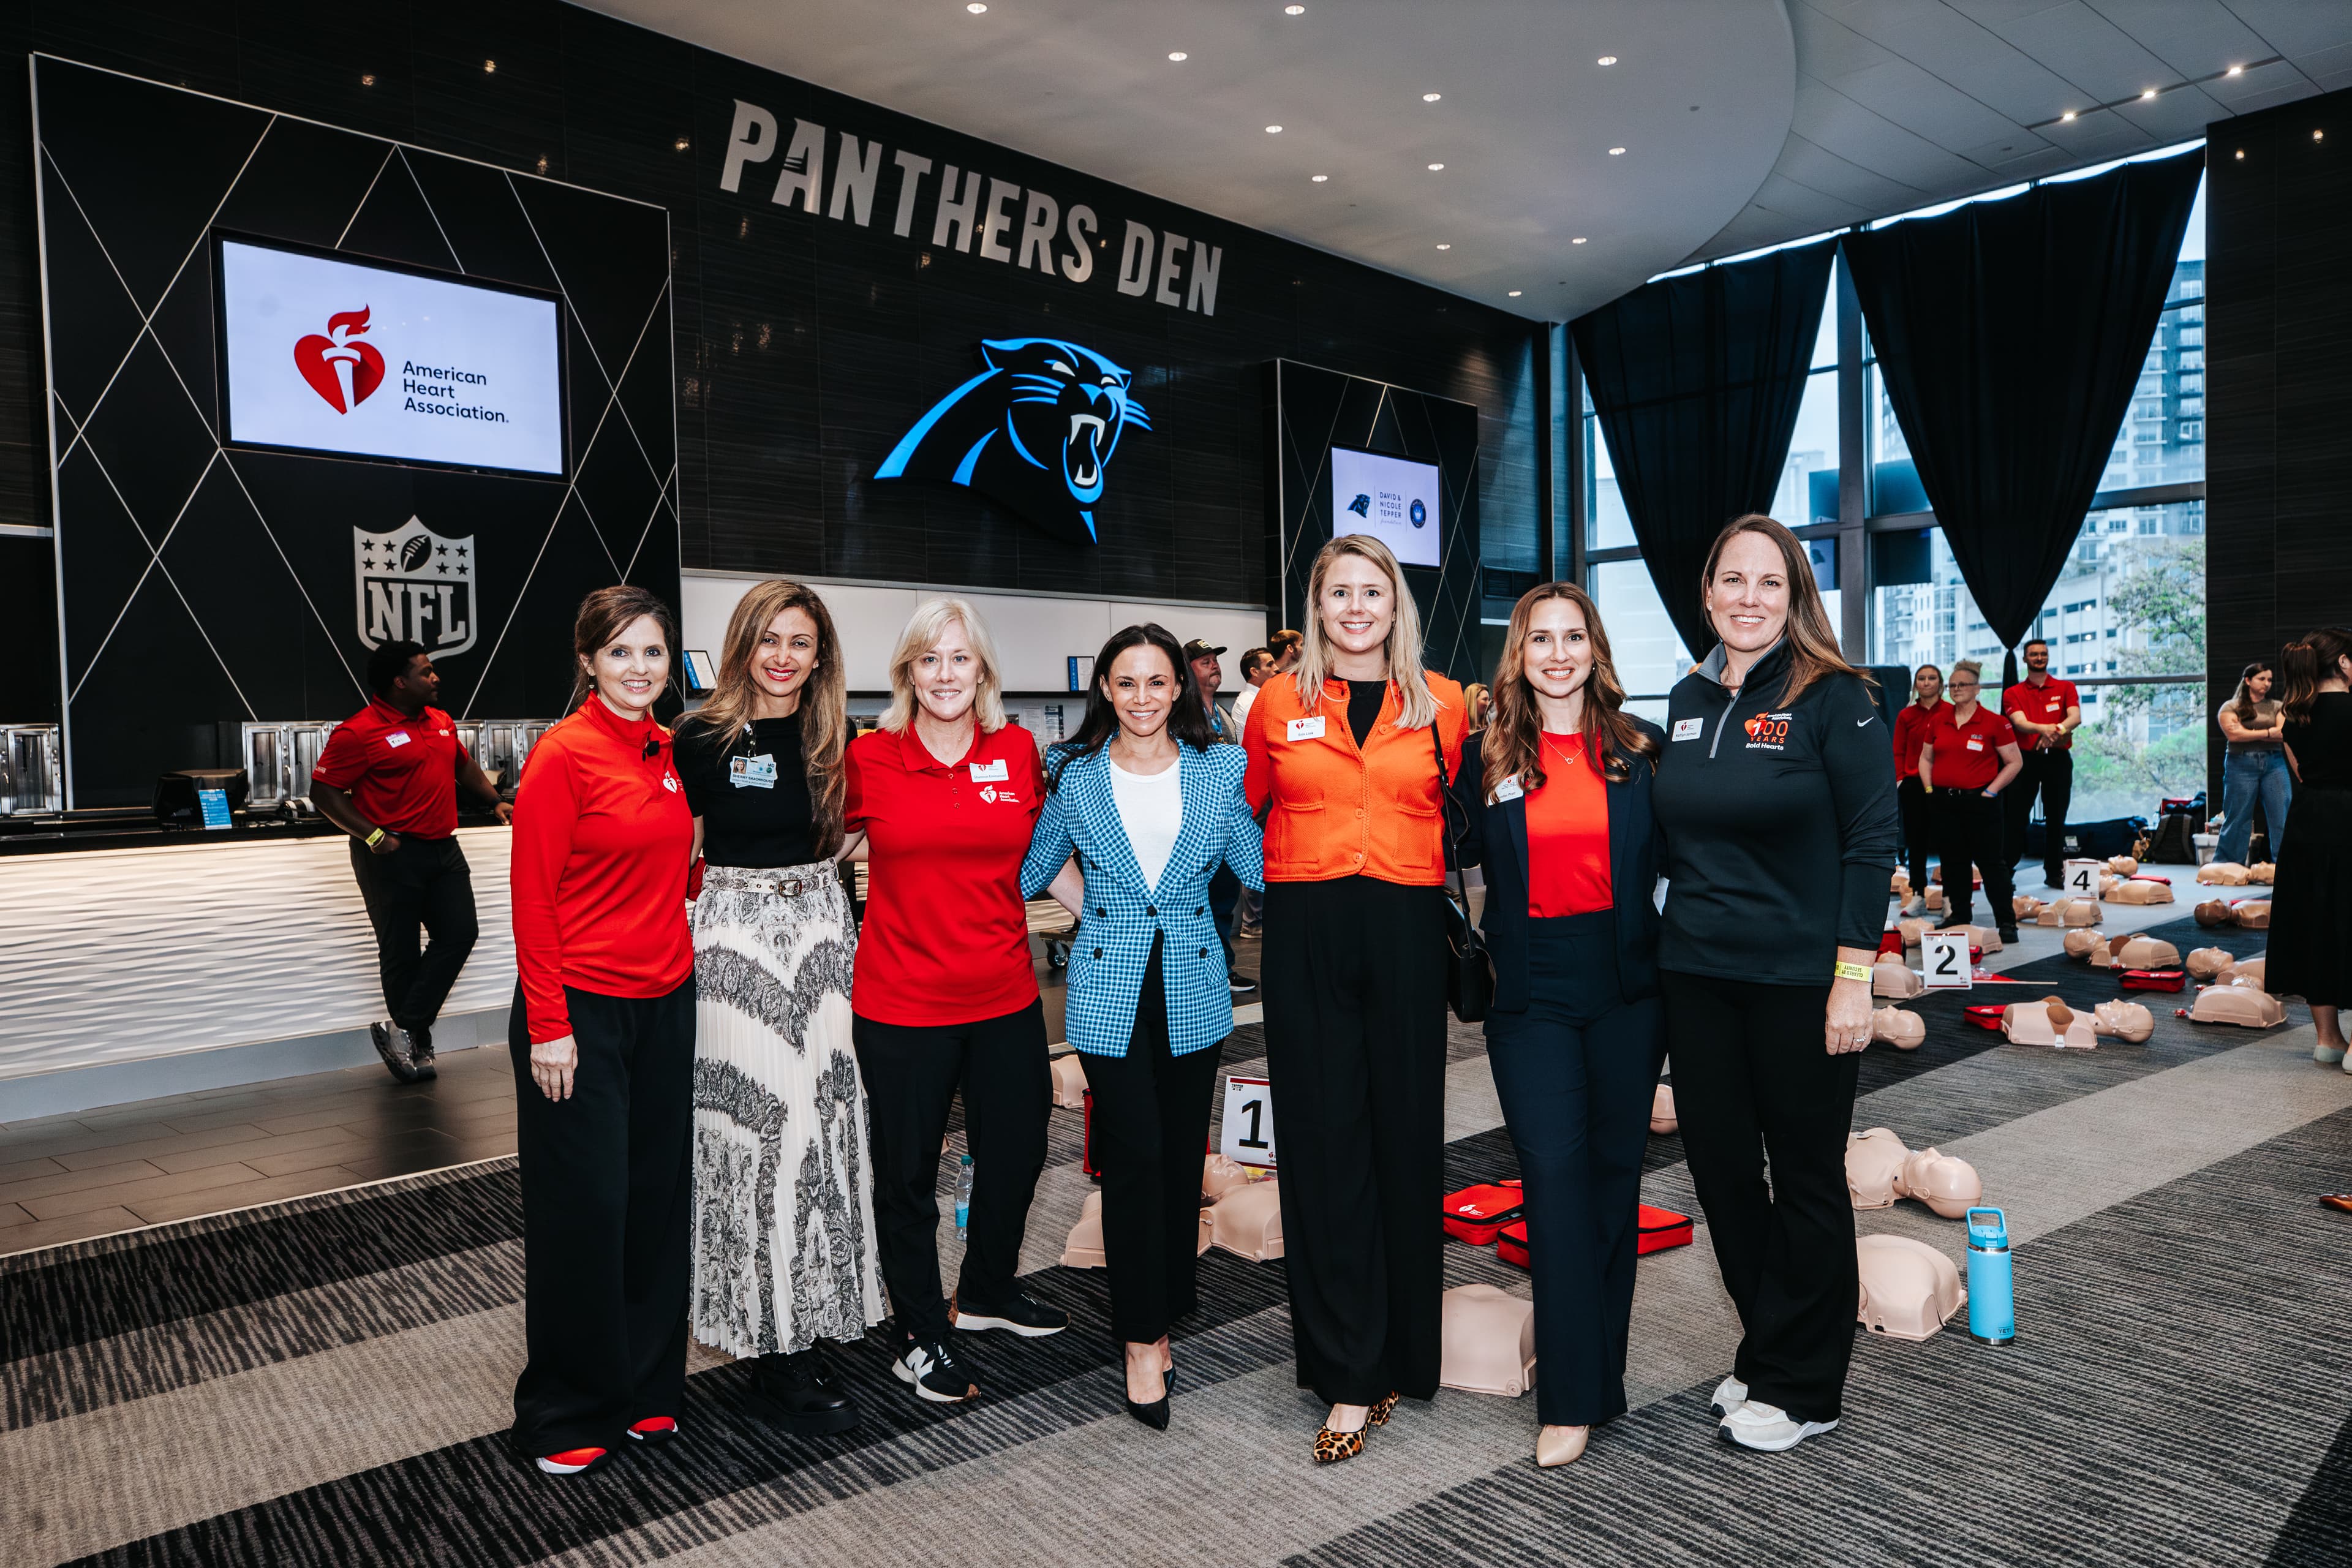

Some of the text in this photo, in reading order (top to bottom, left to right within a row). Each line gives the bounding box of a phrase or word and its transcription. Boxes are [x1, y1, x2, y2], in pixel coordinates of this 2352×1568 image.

[720, 99, 1222, 317] PANTHERS DEN
[403, 361, 486, 385] American
[404, 379, 455, 399] Heart
[1380, 501, 1401, 510] NICOLE
[1381, 510, 1401, 518] TEPPER
[368, 581, 466, 646] NFL
[1753, 721, 1789, 737] 100
[2073, 870, 2090, 891] 4
[1934, 945, 1958, 975] 2
[1238, 1099, 1268, 1150] 1
